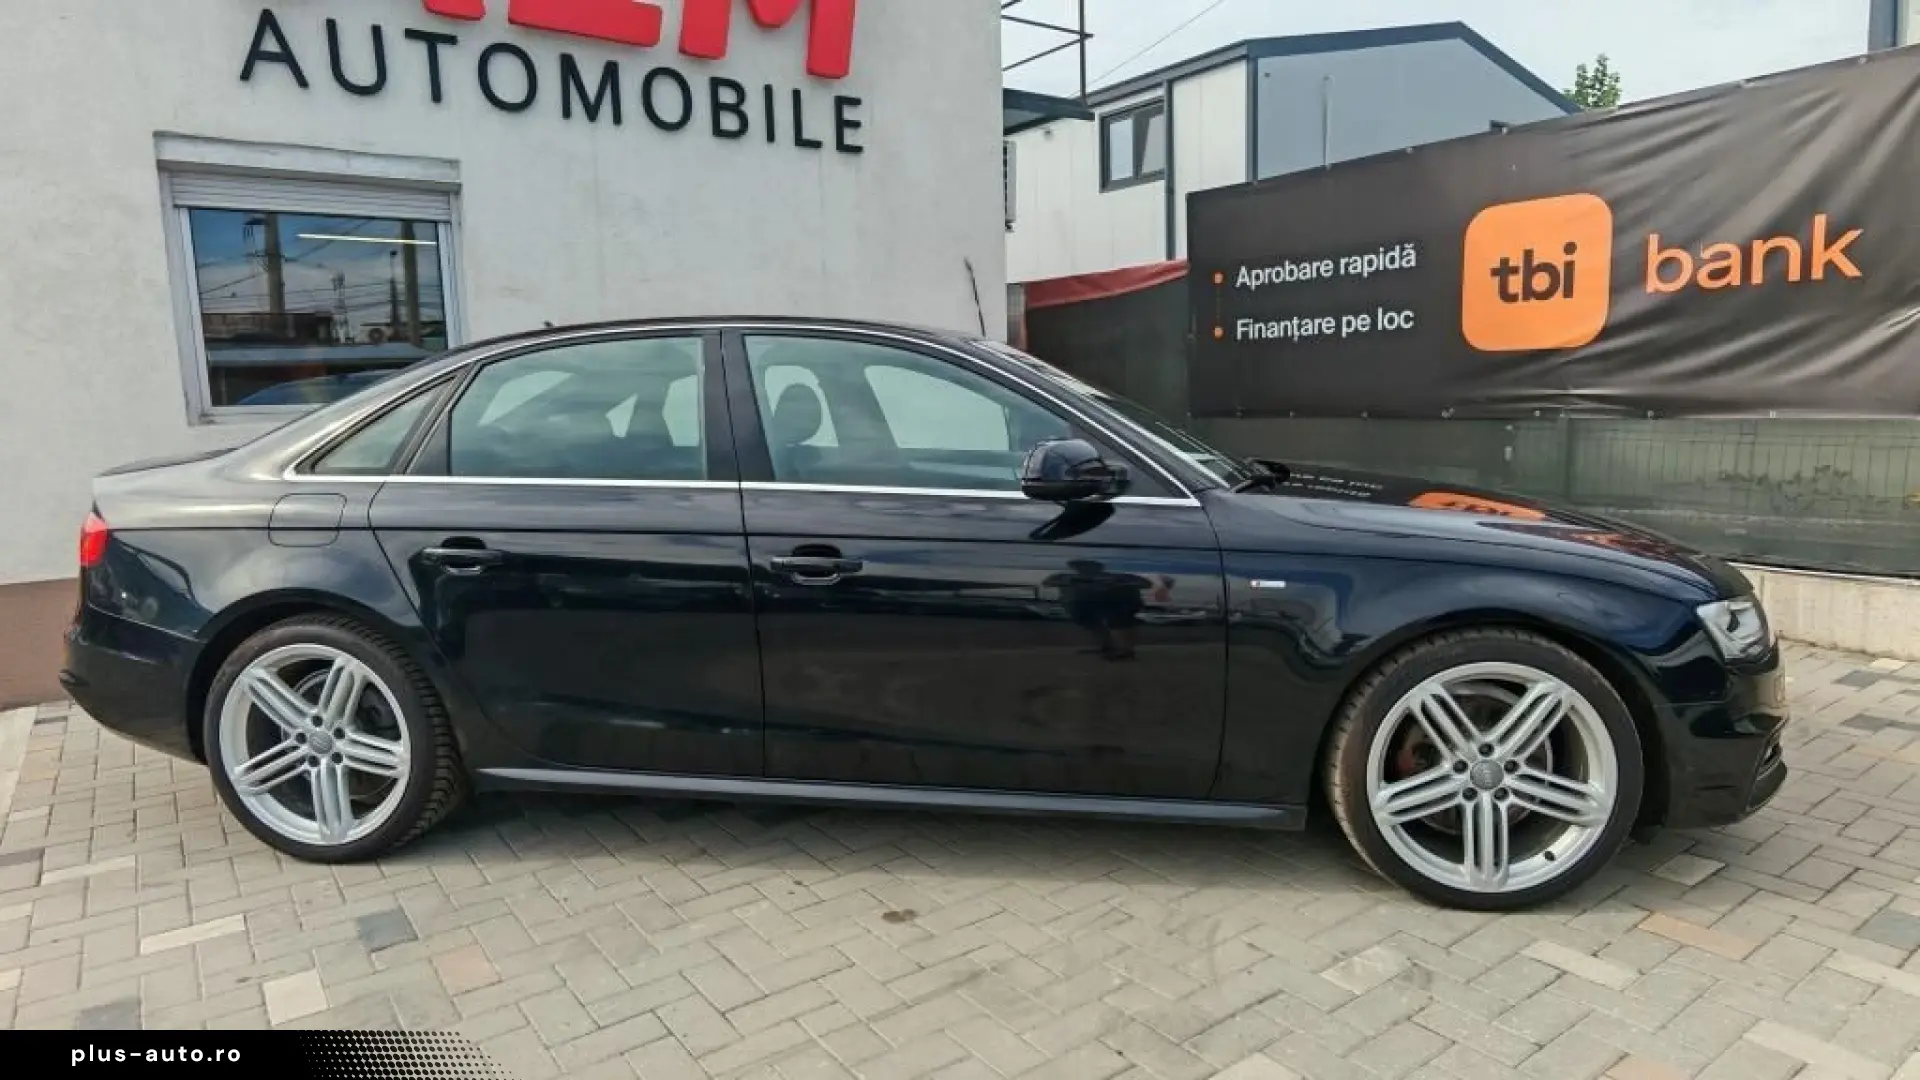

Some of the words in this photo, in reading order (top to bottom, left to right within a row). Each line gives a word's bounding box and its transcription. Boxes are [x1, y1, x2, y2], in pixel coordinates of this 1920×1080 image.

[240, 8, 864, 154] AUTOMOBILE
[1235, 259, 1334, 291] Aprobare
[1339, 243, 1417, 278] rapidă
[1490, 240, 1577, 303] tbi
[1645, 213, 1863, 293] bank
[1236, 315, 1336, 342] Finanțare
[1341, 313, 1372, 338] pe
[1377, 306, 1415, 331] loc
